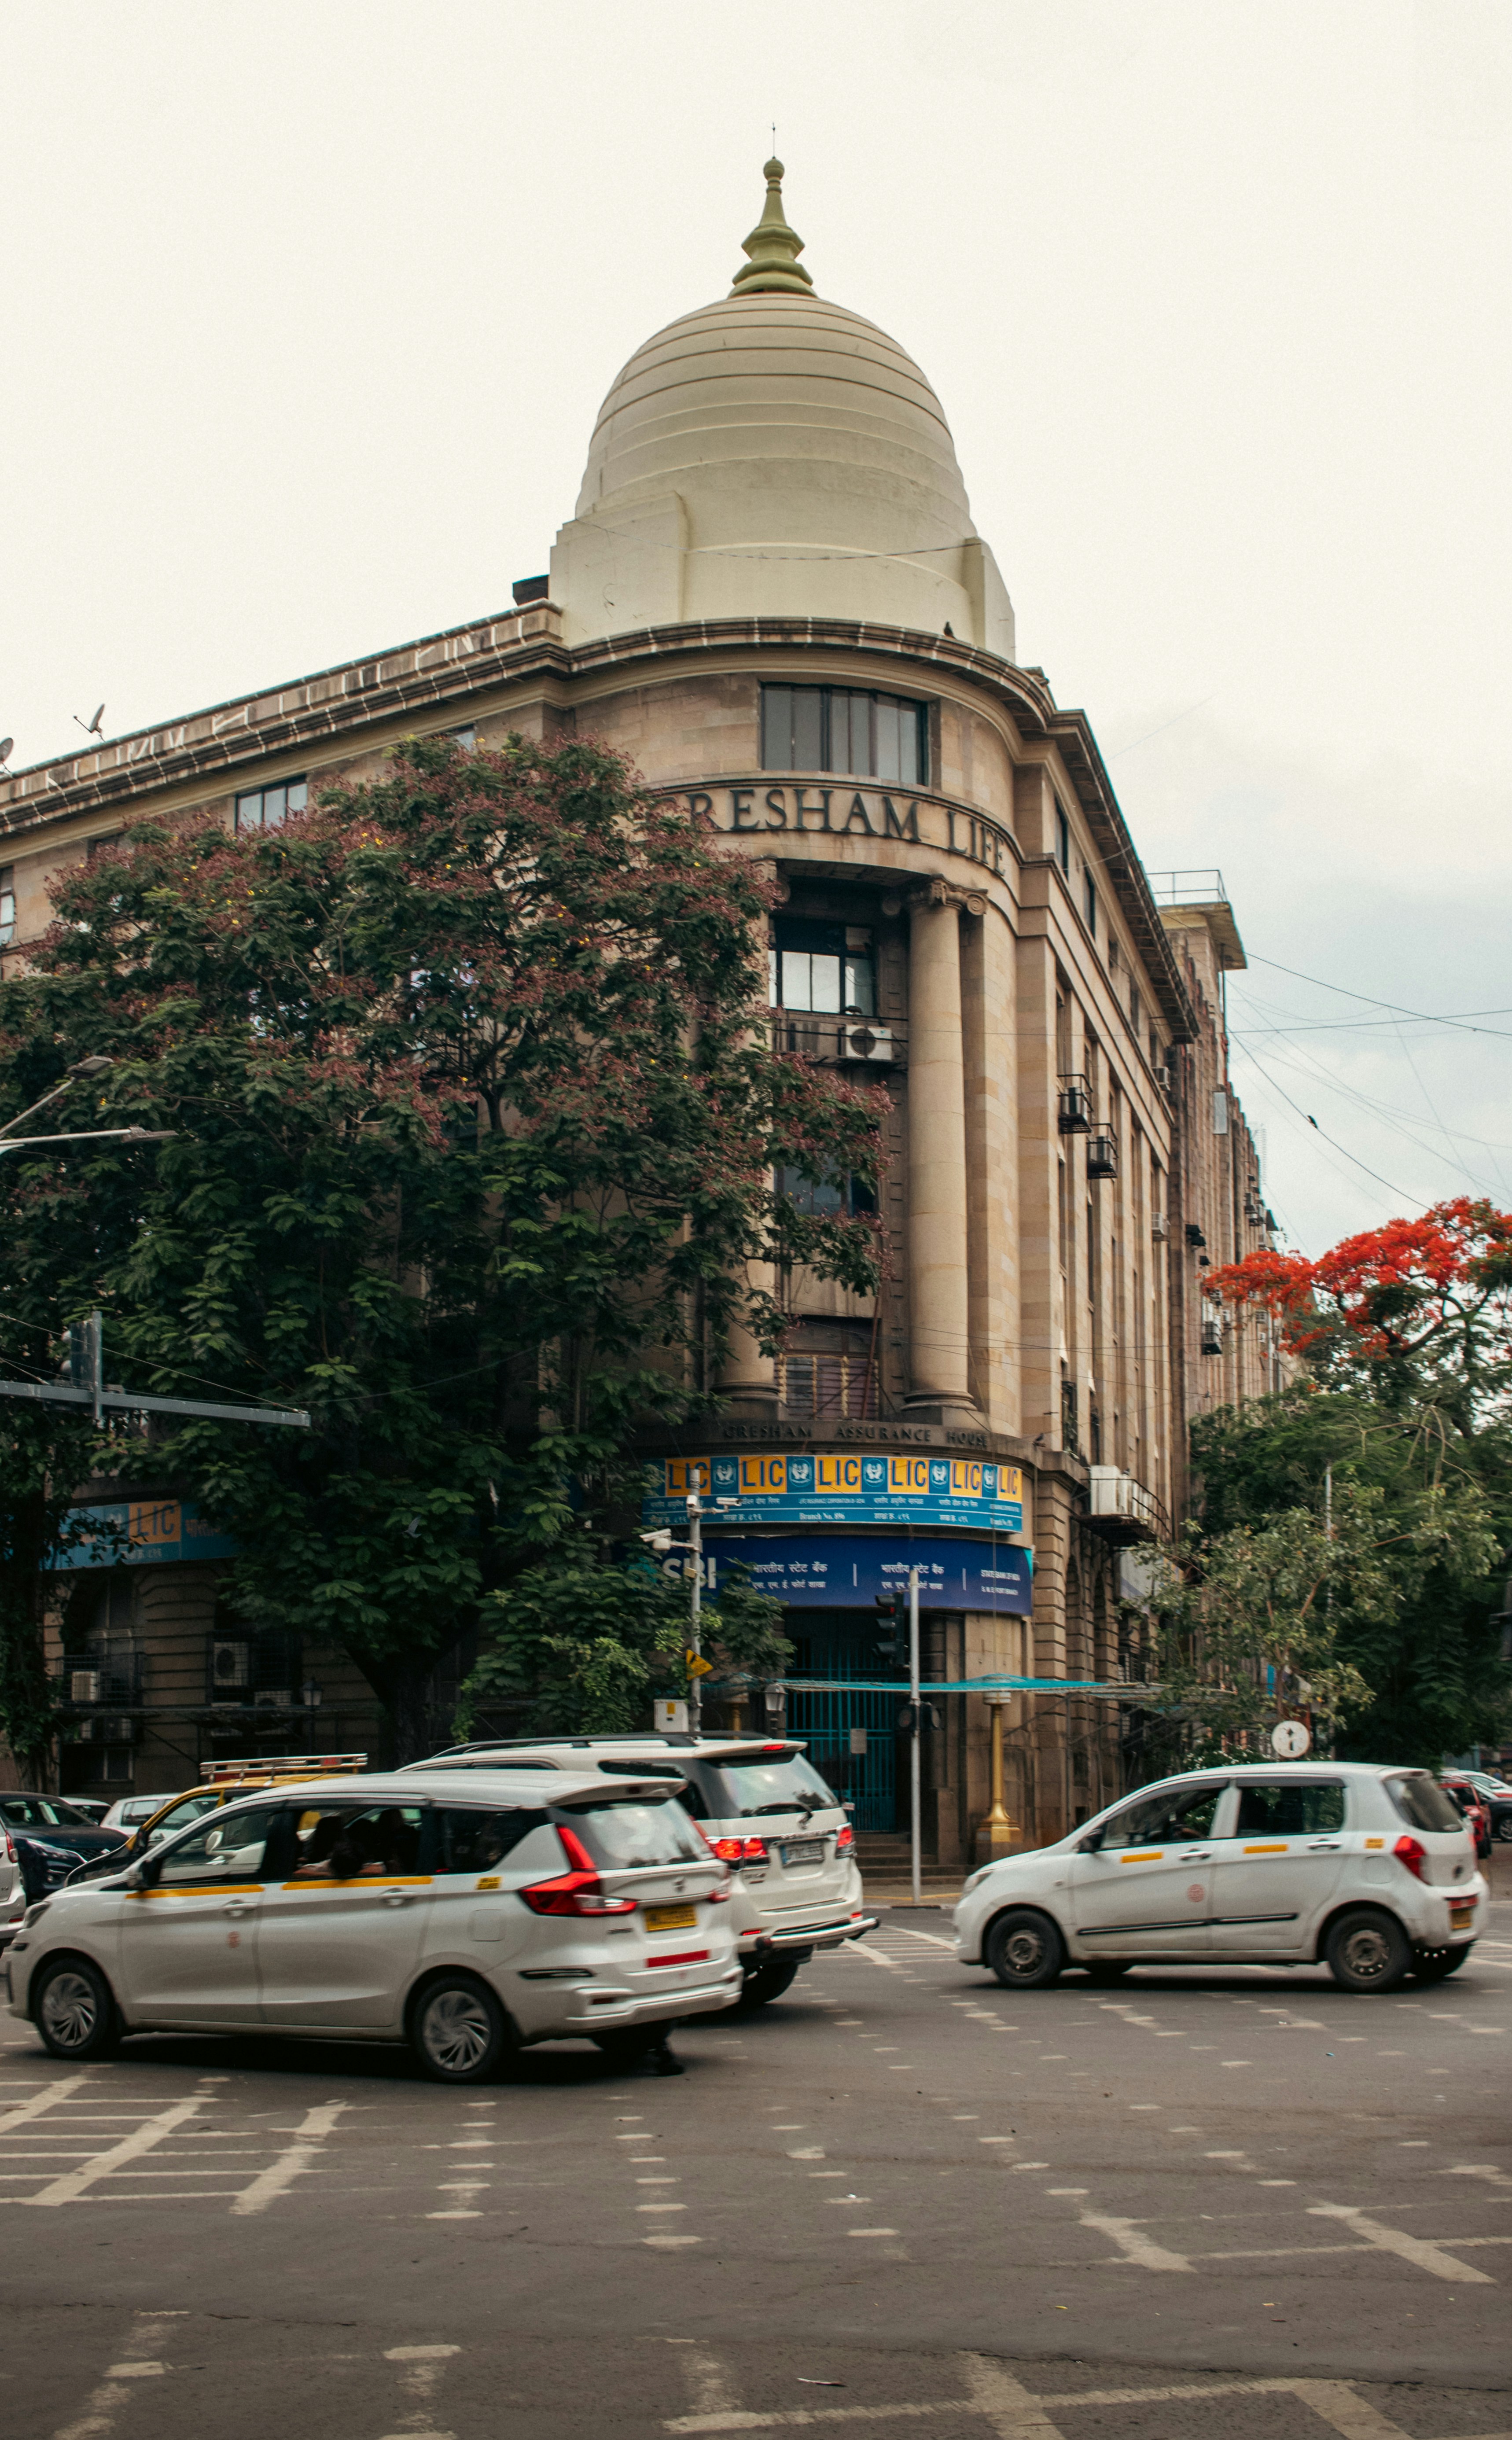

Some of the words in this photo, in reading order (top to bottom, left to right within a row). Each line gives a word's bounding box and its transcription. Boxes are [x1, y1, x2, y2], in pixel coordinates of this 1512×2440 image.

[646, 788, 922, 842] RESHAM
[947, 810, 1006, 876] LIFE
[724, 1424, 812, 1439] GRESHAM
[836, 1425, 932, 1442] ASSURANCE
[947, 1431, 989, 1449] HOUSE
[669, 1461, 707, 1489] LIC
[743, 1460, 783, 1486] LIC
[819, 1459, 858, 1486] LIC
[891, 1460, 927, 1487] LIC
[953, 1463, 981, 1490] LIC
[999, 1467, 1018, 1495] LIC
[136, 1504, 175, 1537] LIC
[788, 1560, 809, 1573] स्टेट
[881, 1562, 910, 1573] भारतीय
